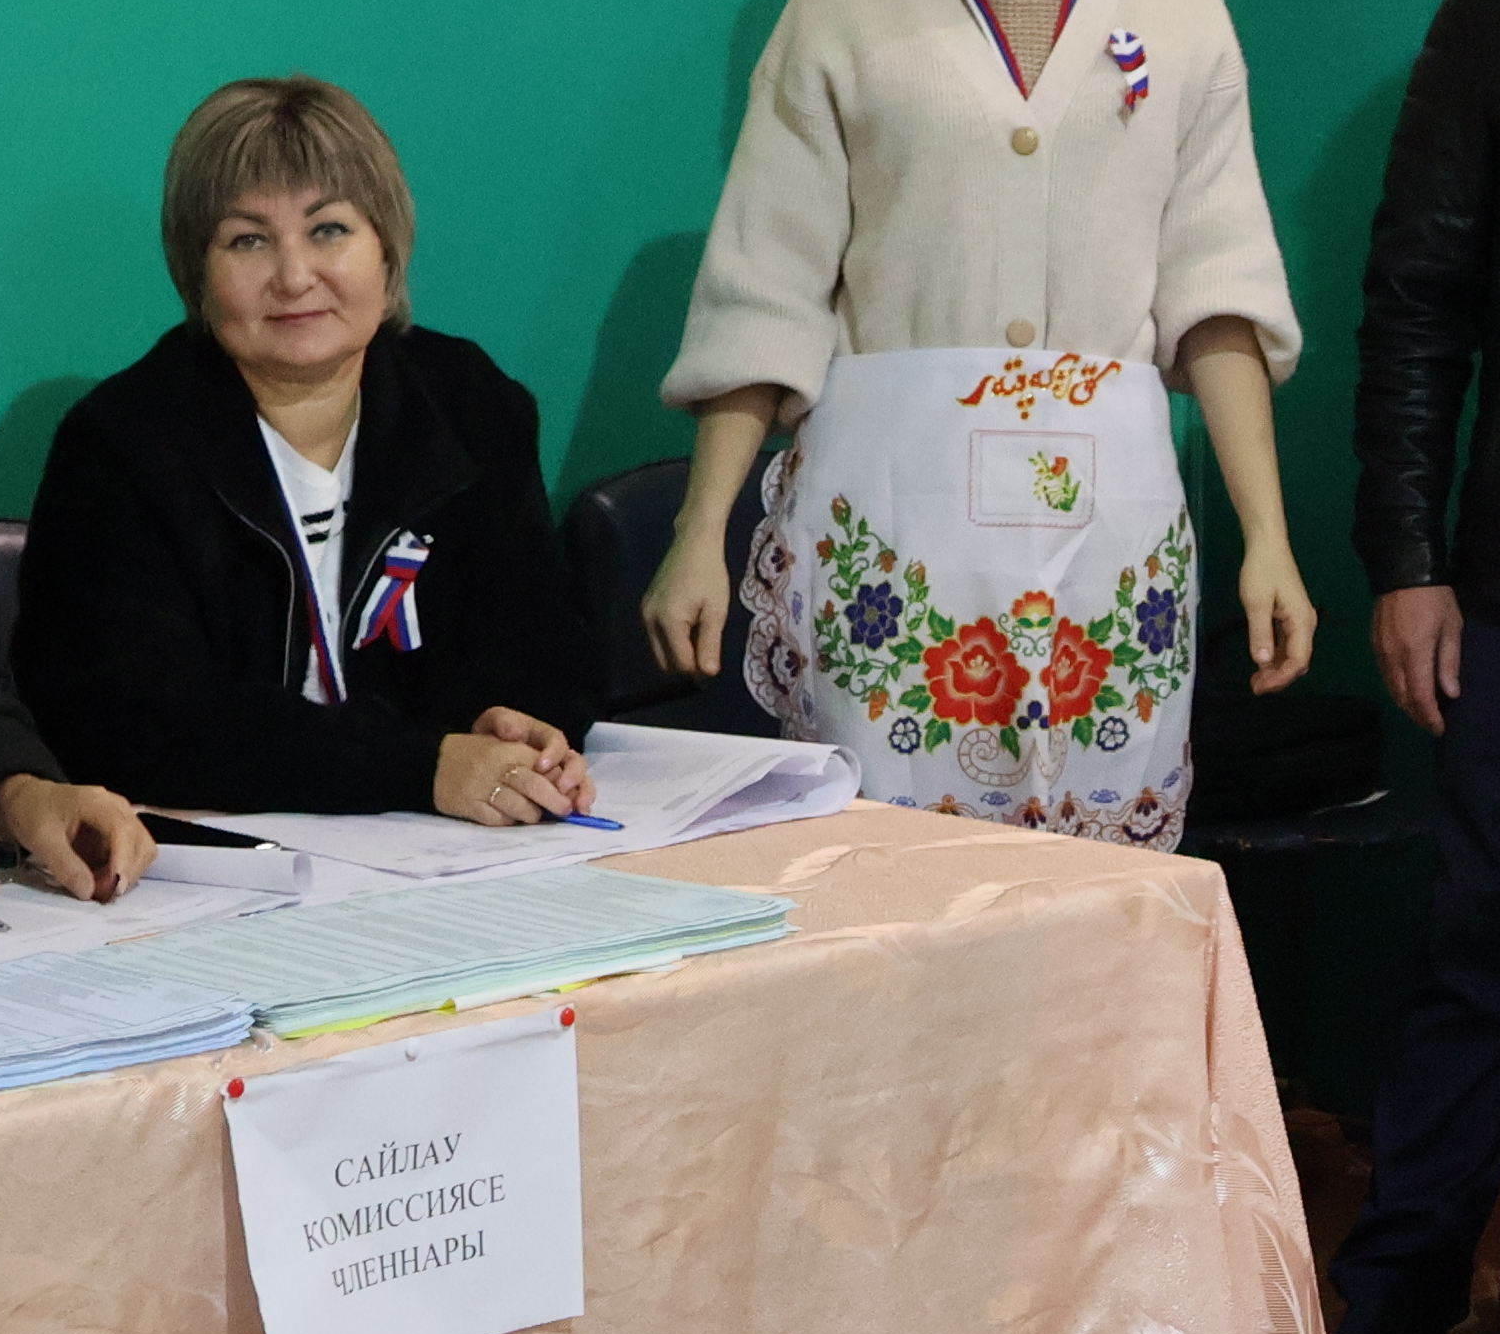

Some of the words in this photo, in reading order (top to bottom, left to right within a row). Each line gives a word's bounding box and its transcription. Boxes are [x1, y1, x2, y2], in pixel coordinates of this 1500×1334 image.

[334, 1133, 462, 1188] САЙЛАУ
[303, 1174, 506, 1253] КОМИССИЯСЕ
[331, 1230, 487, 1297] ЧЛЕННАРЫ
